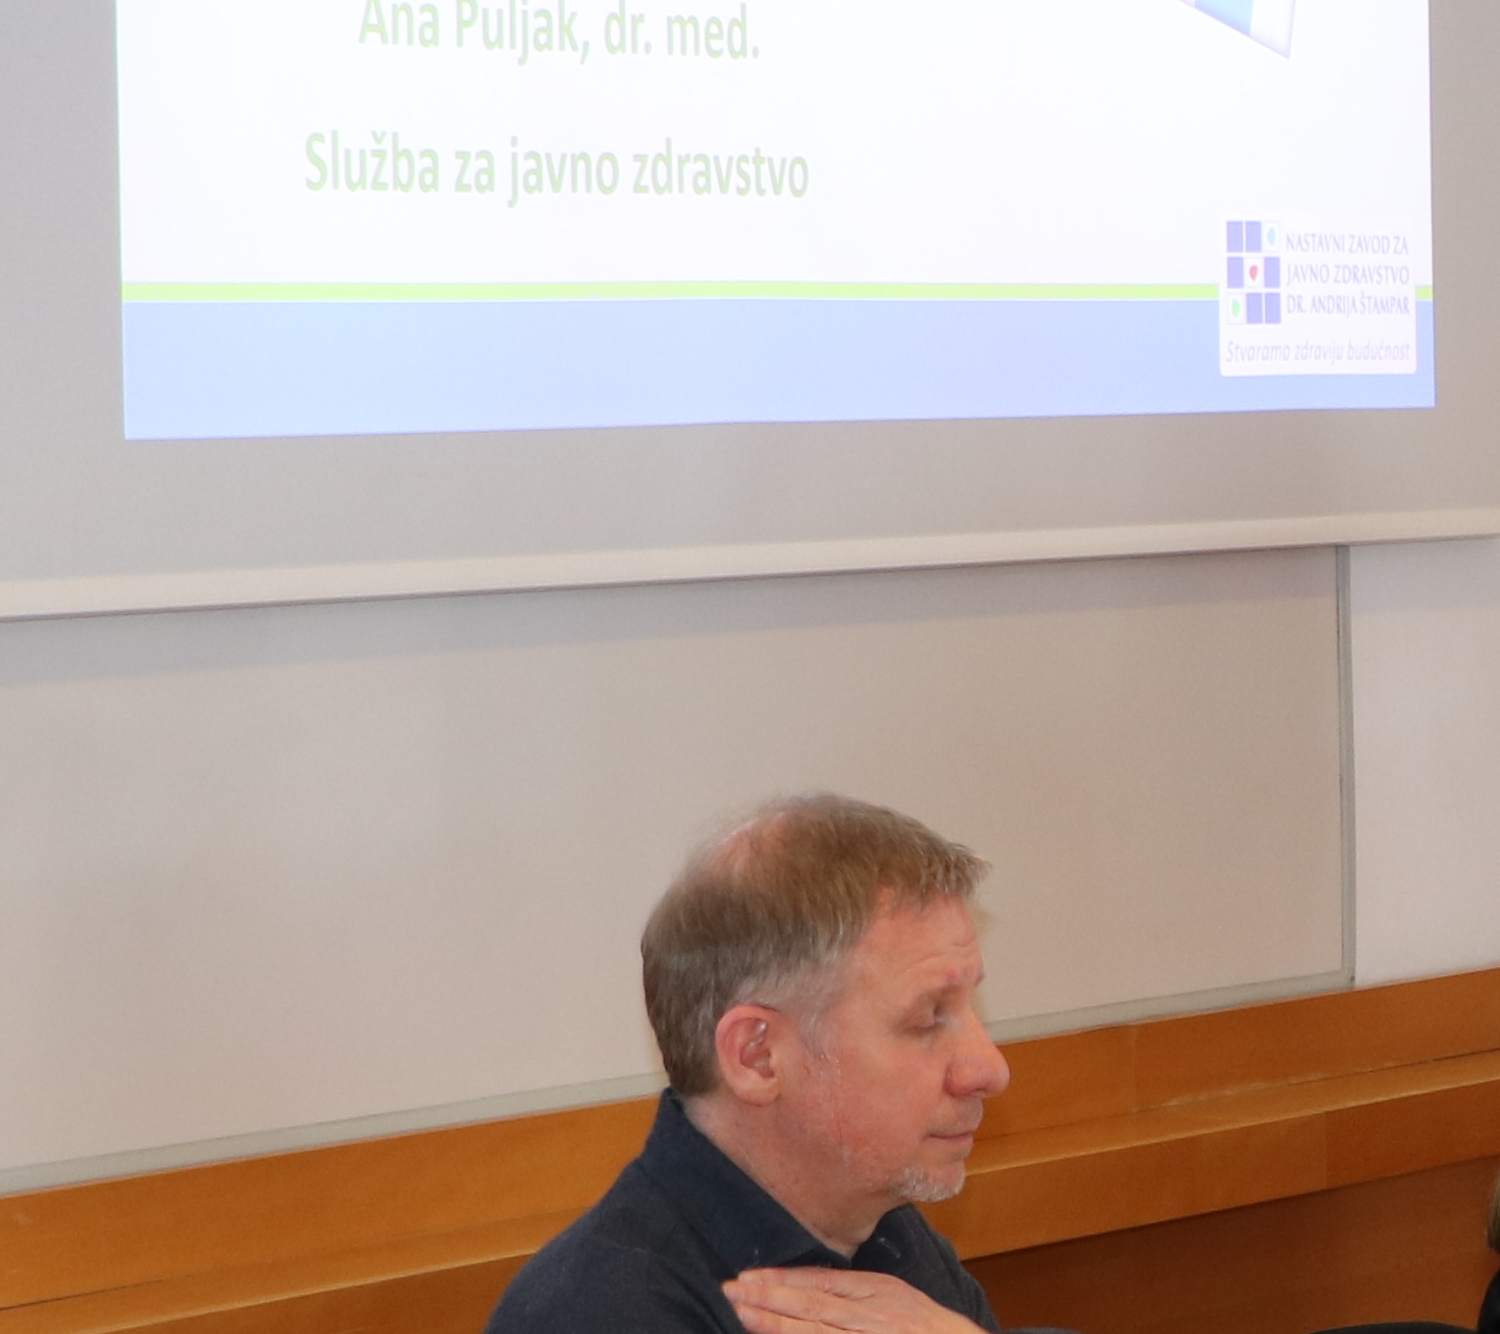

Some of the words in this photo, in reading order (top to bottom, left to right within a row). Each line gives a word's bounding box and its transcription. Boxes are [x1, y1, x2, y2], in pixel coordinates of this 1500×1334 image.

[664, 1, 762, 60] med.
[303, 128, 441, 194] Služba
[452, 146, 497, 195] za
[506, 134, 621, 210] javno
[631, 136, 811, 200] zdravstvo
[1285, 232, 1345, 253] NASTAVNI
[1348, 234, 1390, 255] ZAVOD
[1393, 235, 1410, 255] ZA
[1286, 264, 1330, 287] JAVNO
[1333, 264, 1411, 285] ZDRAVSTVO
[1286, 293, 1306, 315] DR.
[1309, 293, 1359, 318] ANDRIJA
[1360, 290, 1411, 316] ŠTAMPAR
